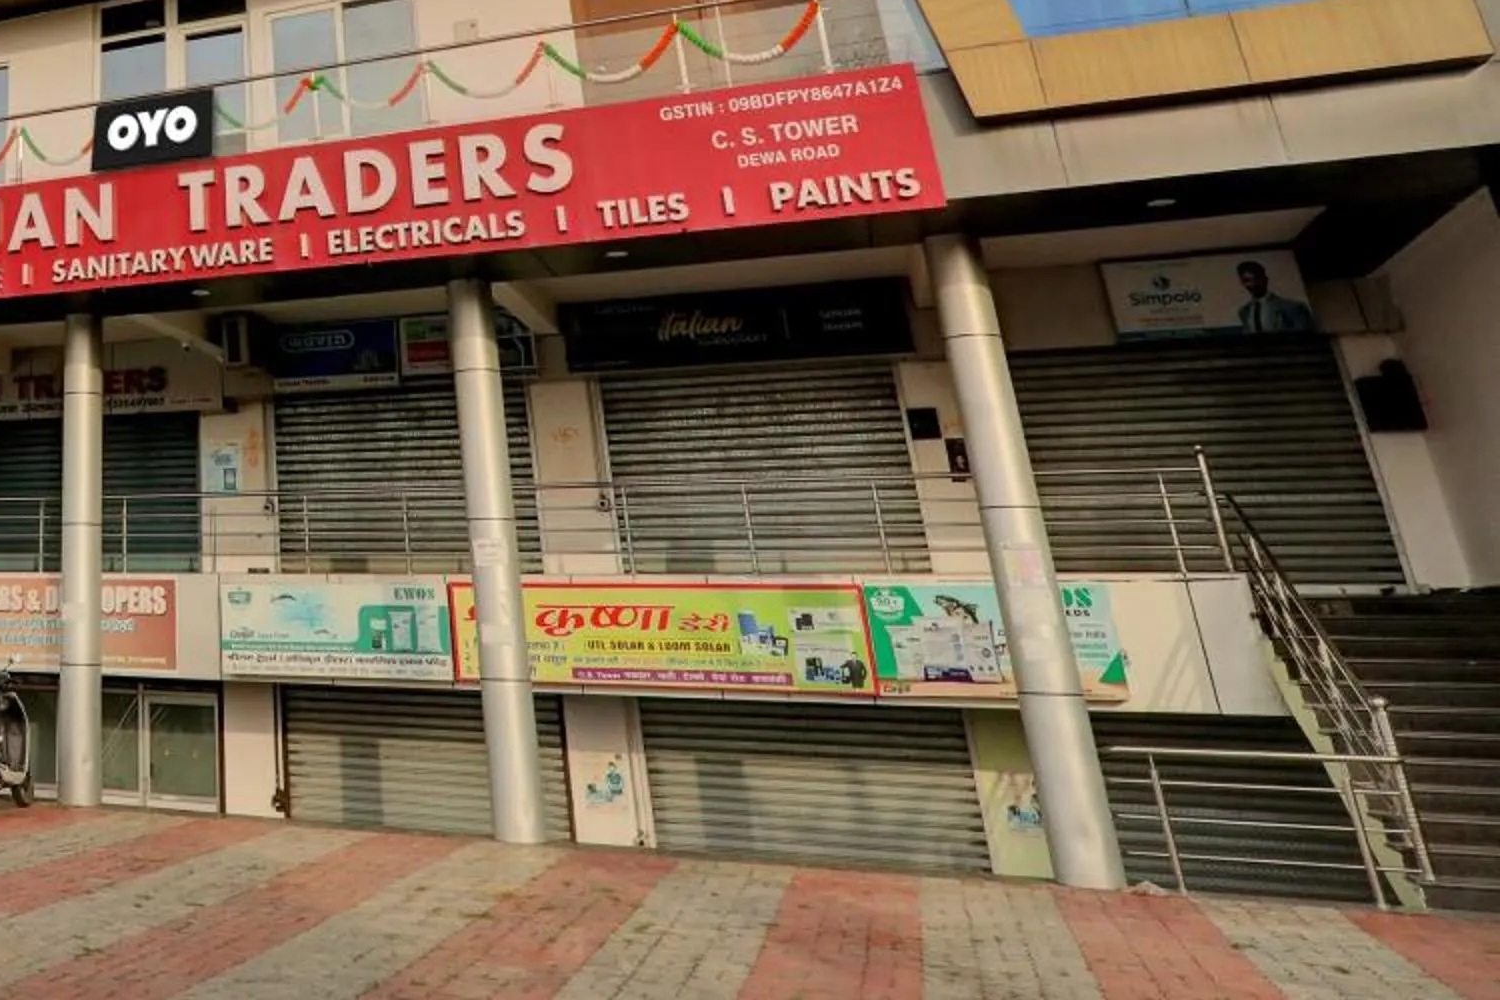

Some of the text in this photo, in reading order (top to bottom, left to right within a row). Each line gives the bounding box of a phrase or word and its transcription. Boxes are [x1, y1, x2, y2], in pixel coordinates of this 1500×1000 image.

[660, 102, 714, 121] GSTIN
[107, 105, 198, 152] OYO
[711, 114, 860, 150] C. S. TOWER
[737, 144, 841, 168] DEWA ROAD
[178, 123, 575, 233] TRADERS
[51, 237, 273, 284] SANITARYWARE
[326, 209, 526, 256] ELECTRICALS
[597, 193, 690, 229] TILES
[769, 167, 922, 212] PAINTS
[25, 587, 42, 613] &
[678, 611, 730, 633] डेरी
